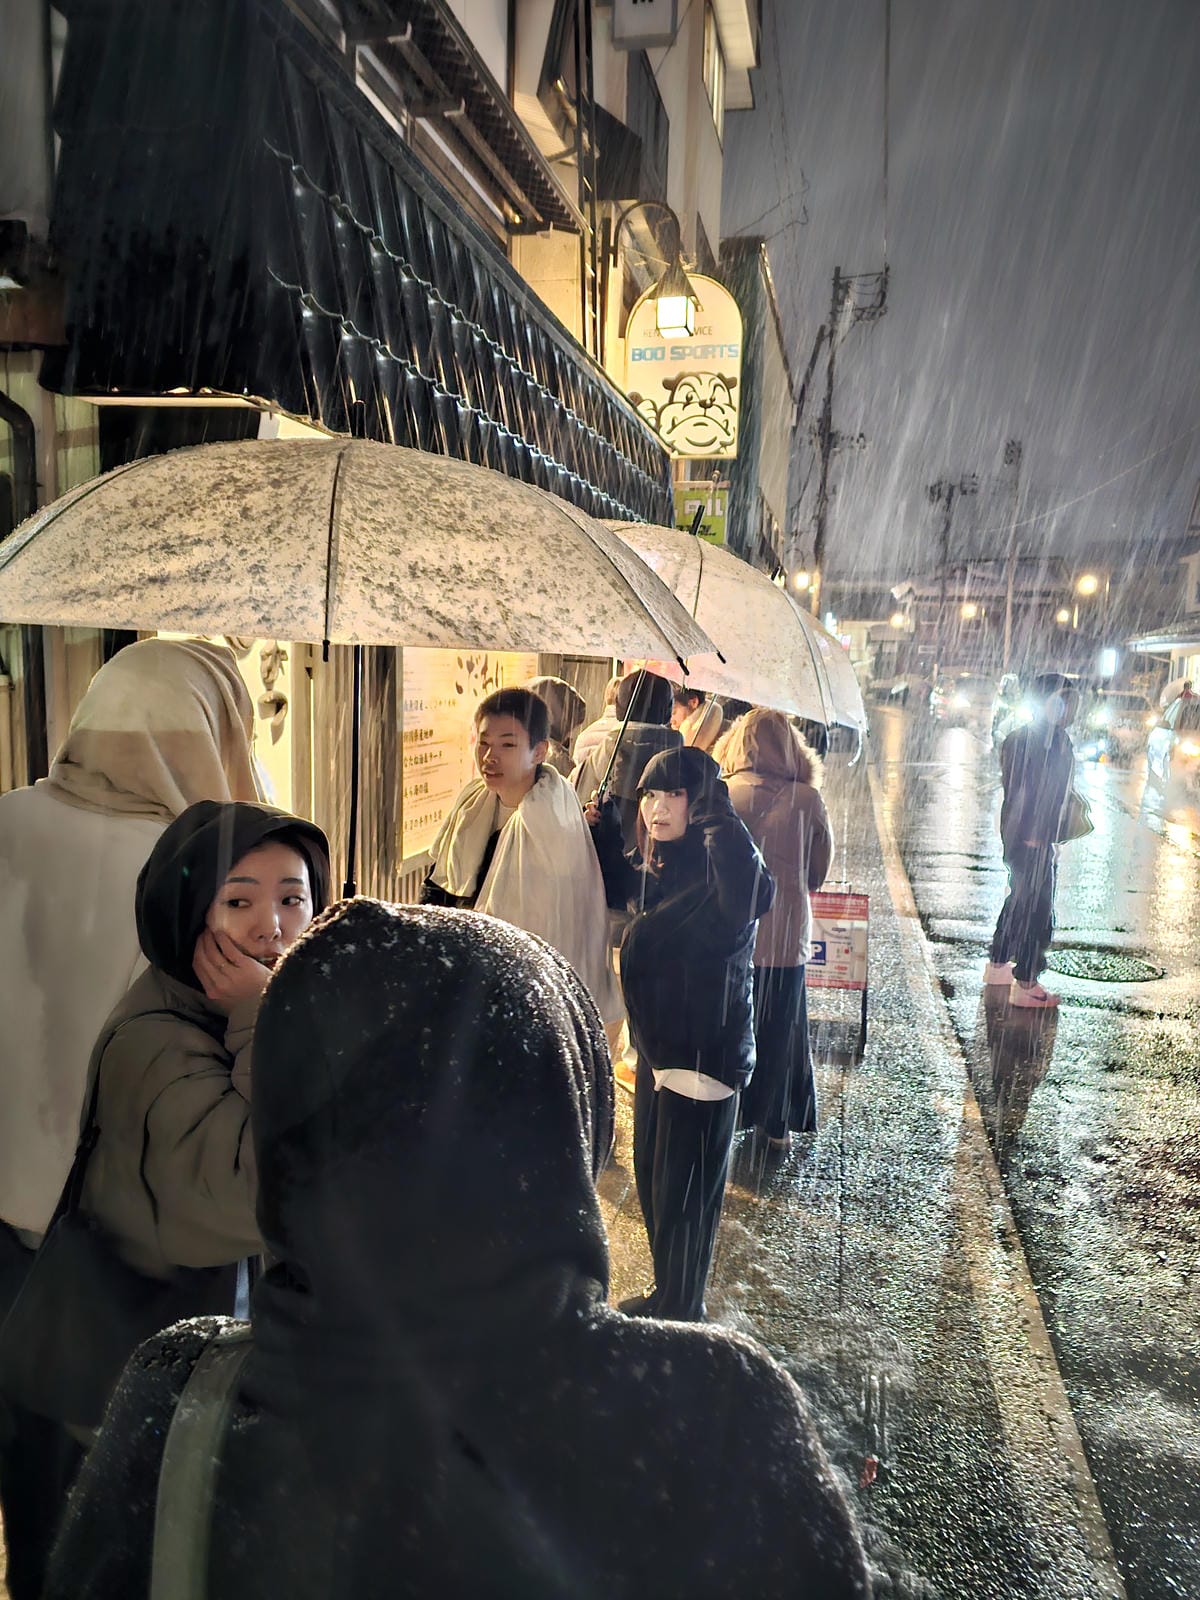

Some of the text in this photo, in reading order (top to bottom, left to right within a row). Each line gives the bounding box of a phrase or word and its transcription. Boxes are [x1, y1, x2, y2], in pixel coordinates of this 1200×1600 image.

[631, 344, 739, 361] BOO SPORTS
[811, 944, 823, 957] P
